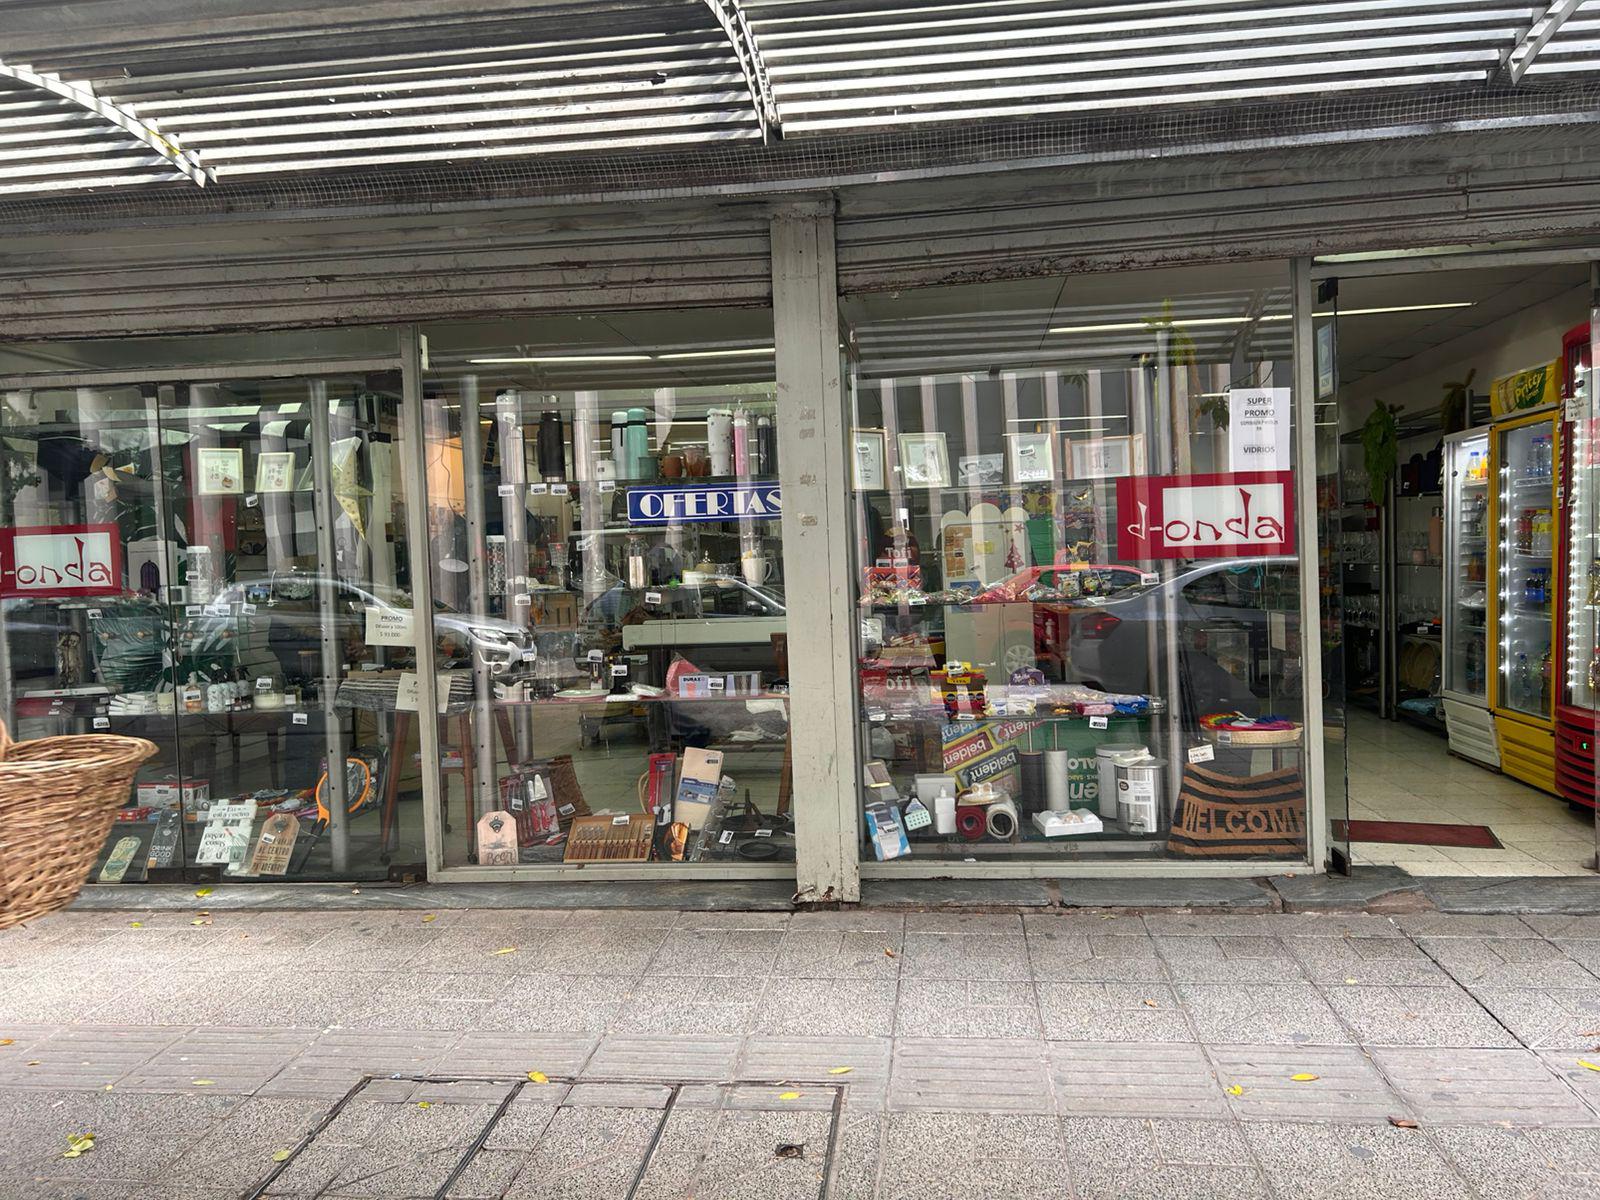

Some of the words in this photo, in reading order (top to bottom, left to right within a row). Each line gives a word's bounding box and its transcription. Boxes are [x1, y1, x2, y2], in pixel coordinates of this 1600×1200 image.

[1247, 397, 1272, 405] SUPER
[1244, 409, 1275, 417] PROMO
[1243, 446, 1275, 454] VIDRIOS
[639, 489, 783, 518] OFERTAS
[885, 546, 912, 559] Tofi
[0, 536, 112, 585] -onda
[969, 752, 1017, 782] beldent
